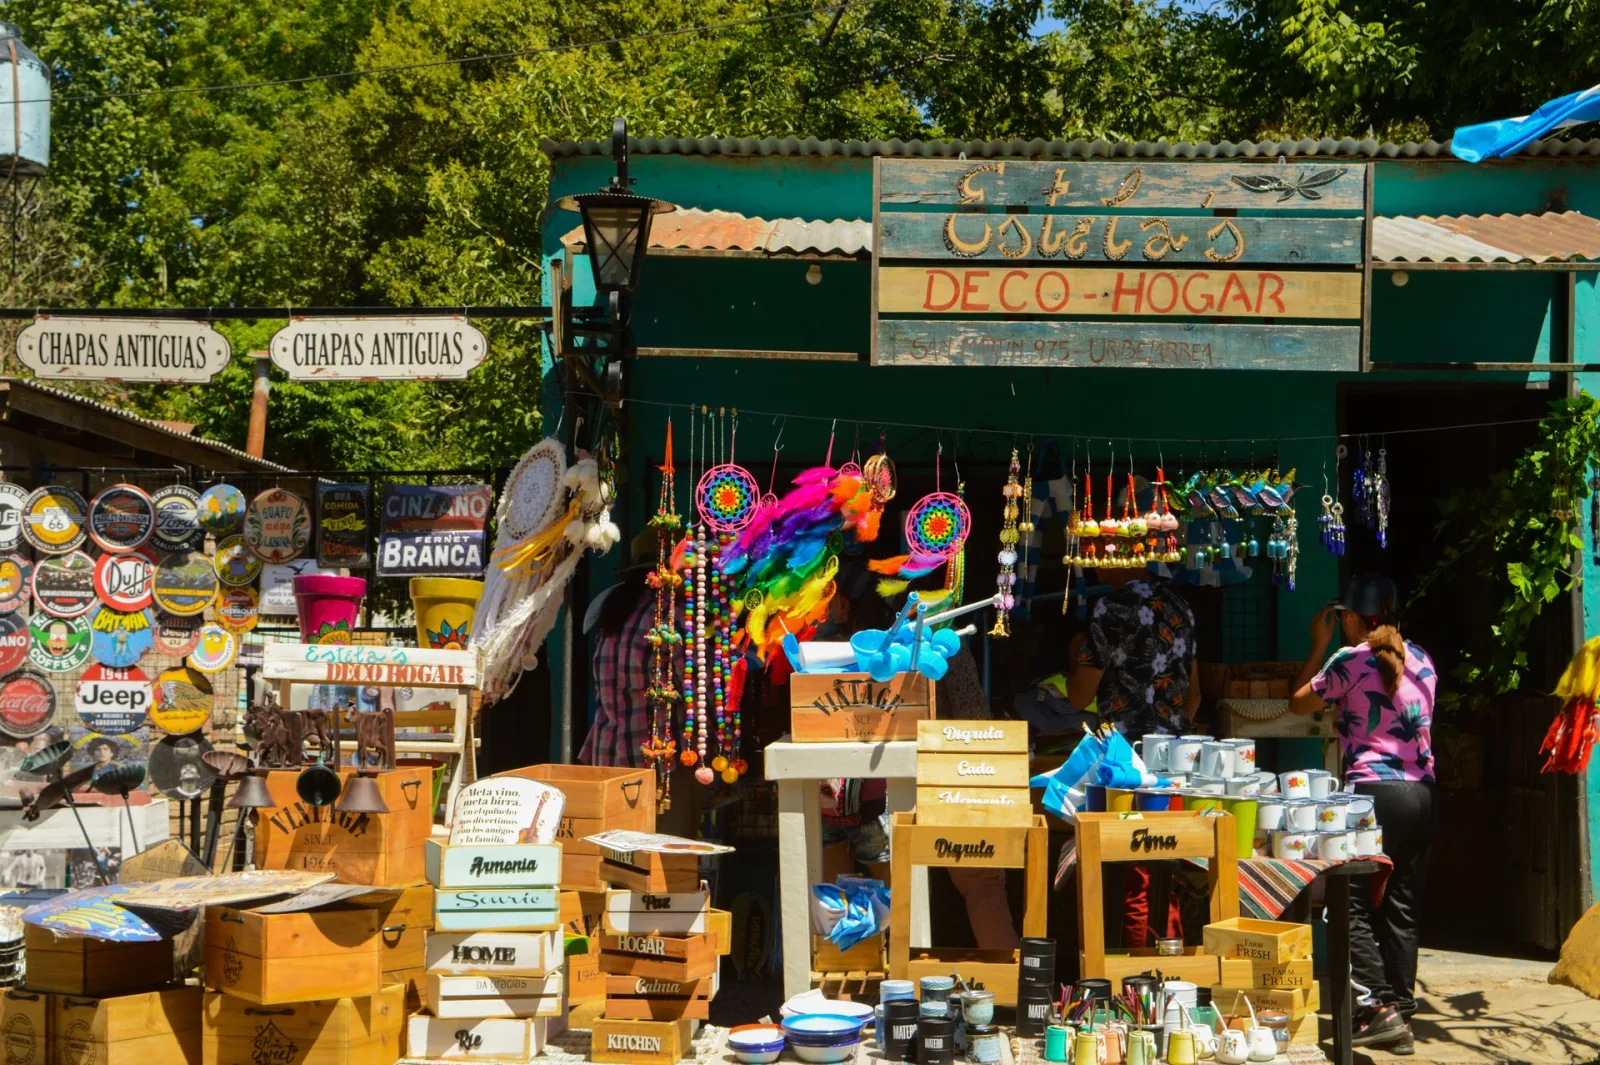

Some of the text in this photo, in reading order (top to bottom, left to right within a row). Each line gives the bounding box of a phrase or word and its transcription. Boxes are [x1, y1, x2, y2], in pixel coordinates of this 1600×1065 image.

[38, 332, 207, 370] CHAPAS ANTIGUAS
[293, 331, 464, 366] CHAPAS ANTIGUAS
[911, 336, 953, 361] SAN
[152, 487, 173, 502] EPAIR
[262, 506, 293, 520] GUAPO
[385, 494, 487, 519] CINZANO
[48, 519, 64, 530] 66
[157, 510, 200, 529] Ford
[414, 535, 471, 544] FERNET
[382, 537, 482, 568] BRANCA
[108, 560, 153, 596] Duff
[91, 606, 150, 633] BATMAN
[219, 607, 259, 615] CHEVROLET
[162, 628, 190, 639] Jeep
[30, 647, 79, 669] COFFEE
[100, 667, 129, 680] 1941
[326, 663, 465, 684] DECO HOGAR
[82, 684, 146, 710] Jeep
[813, 683, 905, 717] VINTAGE
[956, 760, 996, 777] Cada
[468, 787, 493, 797] Meta
[463, 796, 488, 807] meta
[473, 807, 482, 816] el
[472, 816, 518, 825] divertimos
[472, 826, 484, 834] los
[484, 826, 515, 835] amigos
[469, 856, 538, 877] Armonia
[641, 894, 671, 911] Paz
[618, 934, 666, 956] HOGAR
[1235, 943, 1271, 960] FRESH
[1244, 938, 1264, 949] FARM
[451, 944, 517, 964] HOME
[1262, 973, 1303, 986] FRESH
[1272, 967, 1296, 975] FARM
[491, 978, 527, 993] gracias
[635, 977, 681, 994] Calma
[1256, 996, 1277, 1005] FARM
[607, 1033, 662, 1053] KITCHEN
